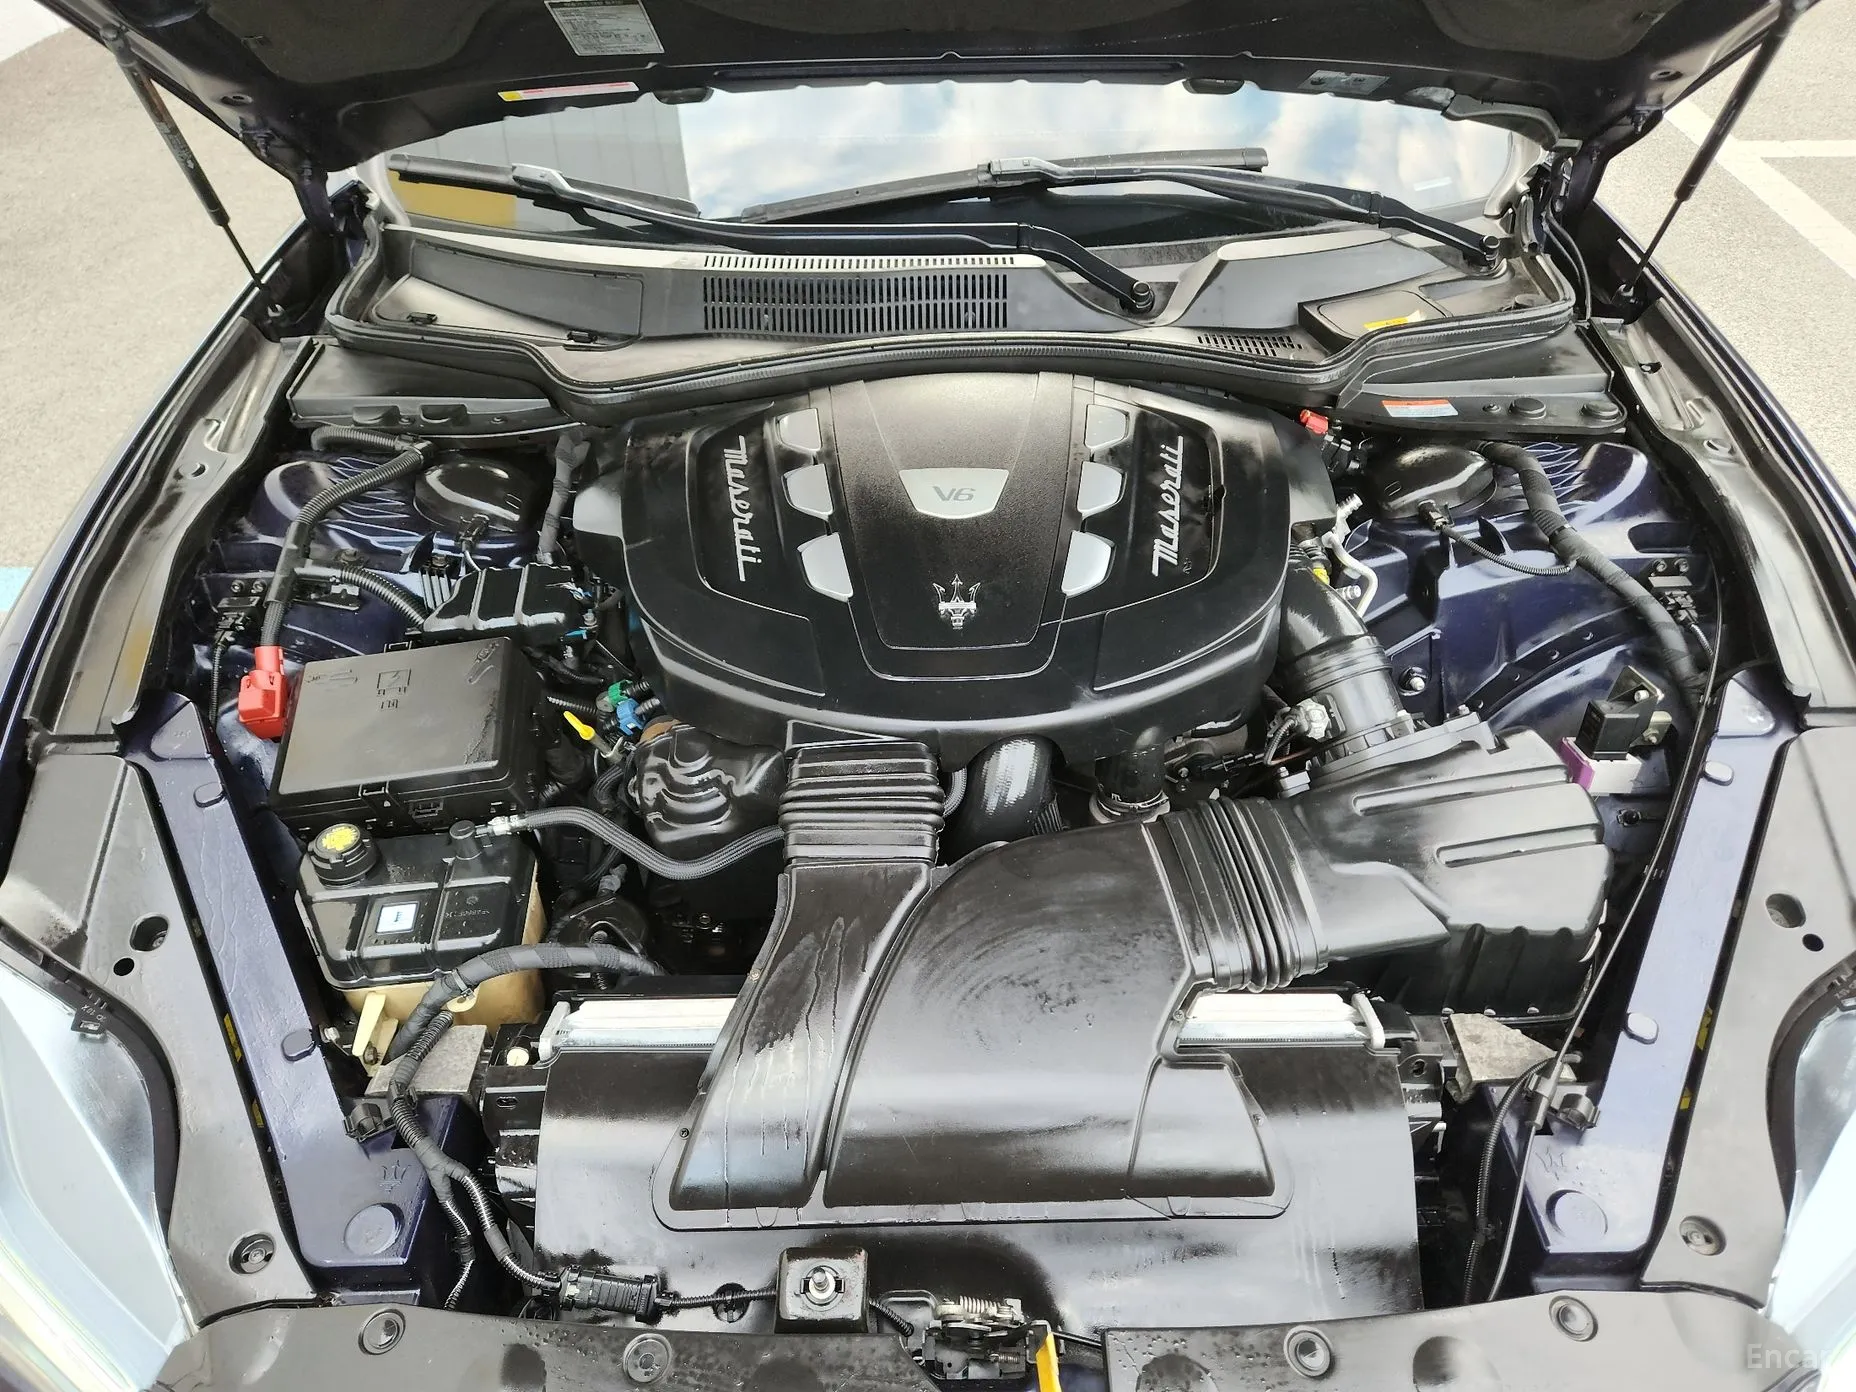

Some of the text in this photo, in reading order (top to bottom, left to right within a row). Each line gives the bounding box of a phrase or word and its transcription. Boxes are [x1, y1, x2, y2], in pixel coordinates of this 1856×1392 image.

[724, 435, 762, 582] Maserati
[932, 485, 976, 502] V6
[1151, 435, 1184, 577] Maserati
